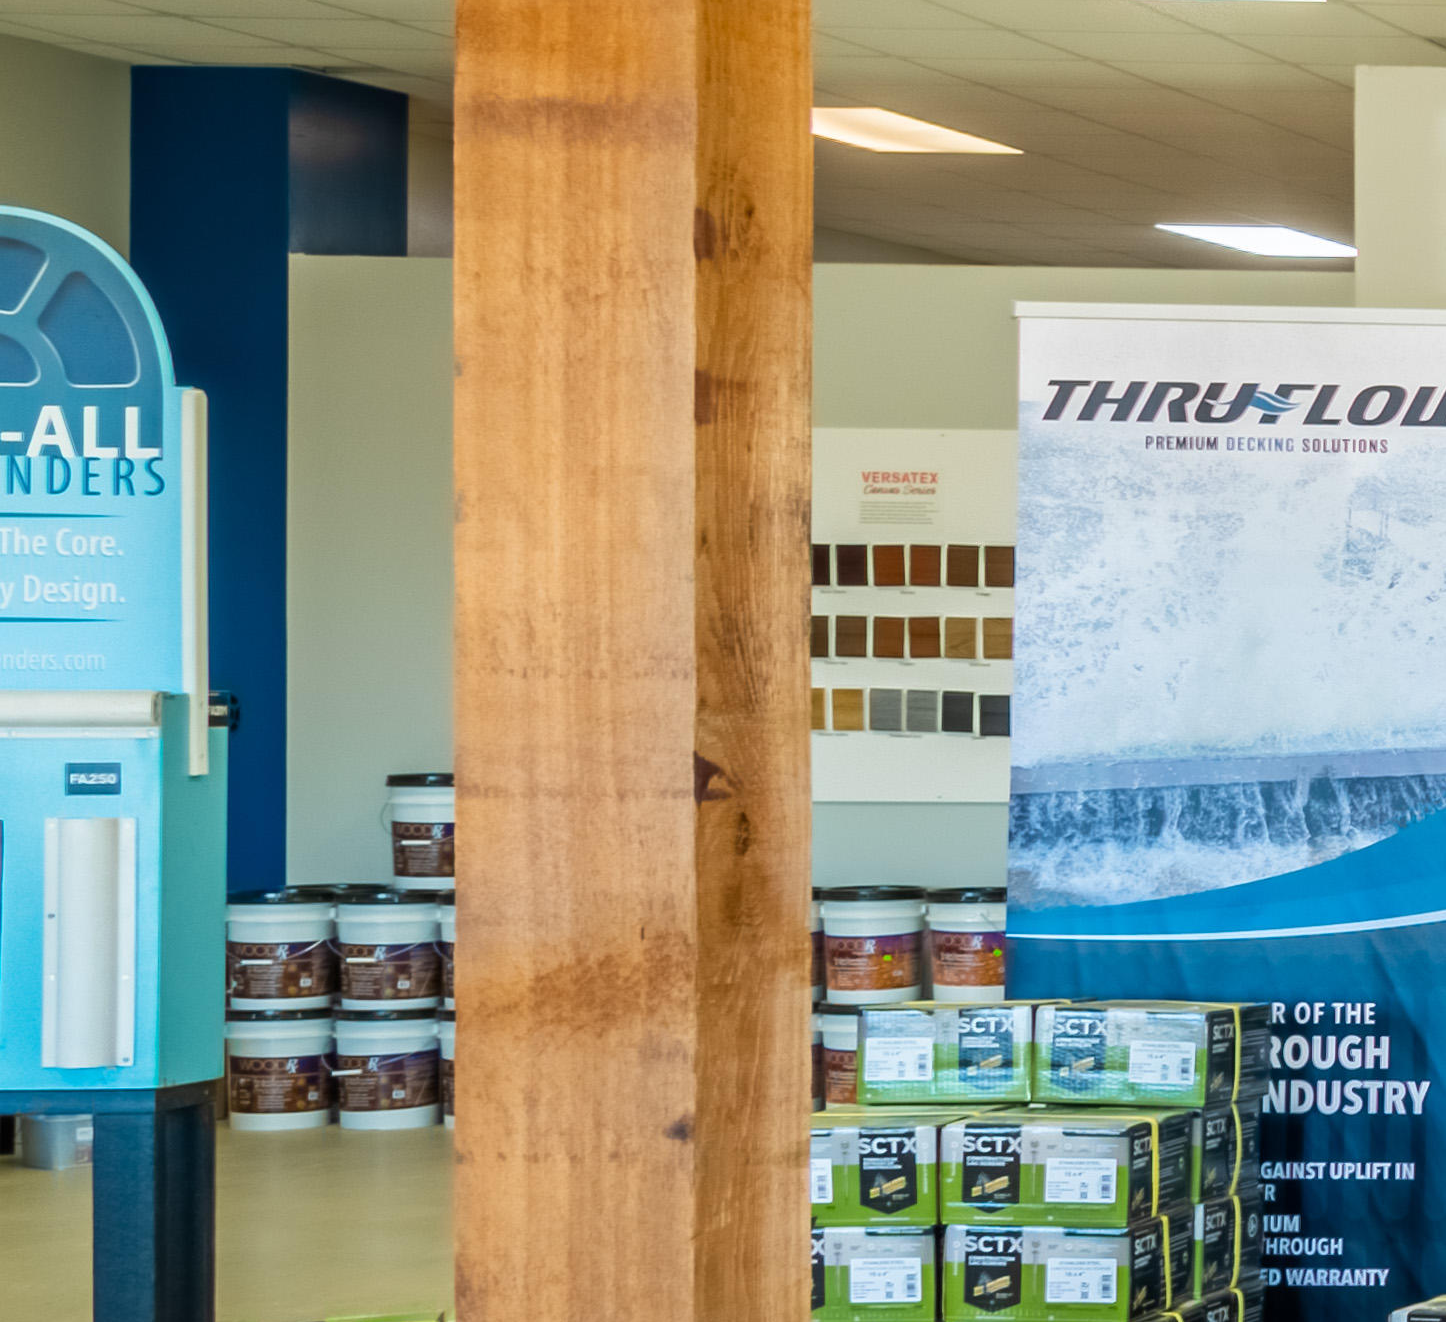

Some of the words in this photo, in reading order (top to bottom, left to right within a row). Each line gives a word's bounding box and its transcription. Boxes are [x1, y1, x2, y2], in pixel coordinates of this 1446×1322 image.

[1144, 435, 1218, 451] PREMIUM
[1225, 437, 1295, 453] DECKING
[1301, 438, 1389, 454] SOLUTIONS
[7, 457, 166, 497] NDERS
[861, 471, 939, 484] VERSATEX
[0, 527, 48, 557] The
[55, 528, 125, 557] Core.
[23, 575, 127, 610] Design.
[1294, 1002, 1325, 1024] OF
[1331, 1002, 1376, 1025] THE
[958, 1016, 1014, 1033] SCTX
[858, 1136, 917, 1155] SCTX
[962, 1135, 1023, 1154] SCTX
[1329, 1162, 1391, 1180] UPLIFT
[1395, 1162, 1415, 1180] IN
[965, 1235, 1024, 1253] SCTX
[1285, 1268, 1390, 1287] WARRANTY
